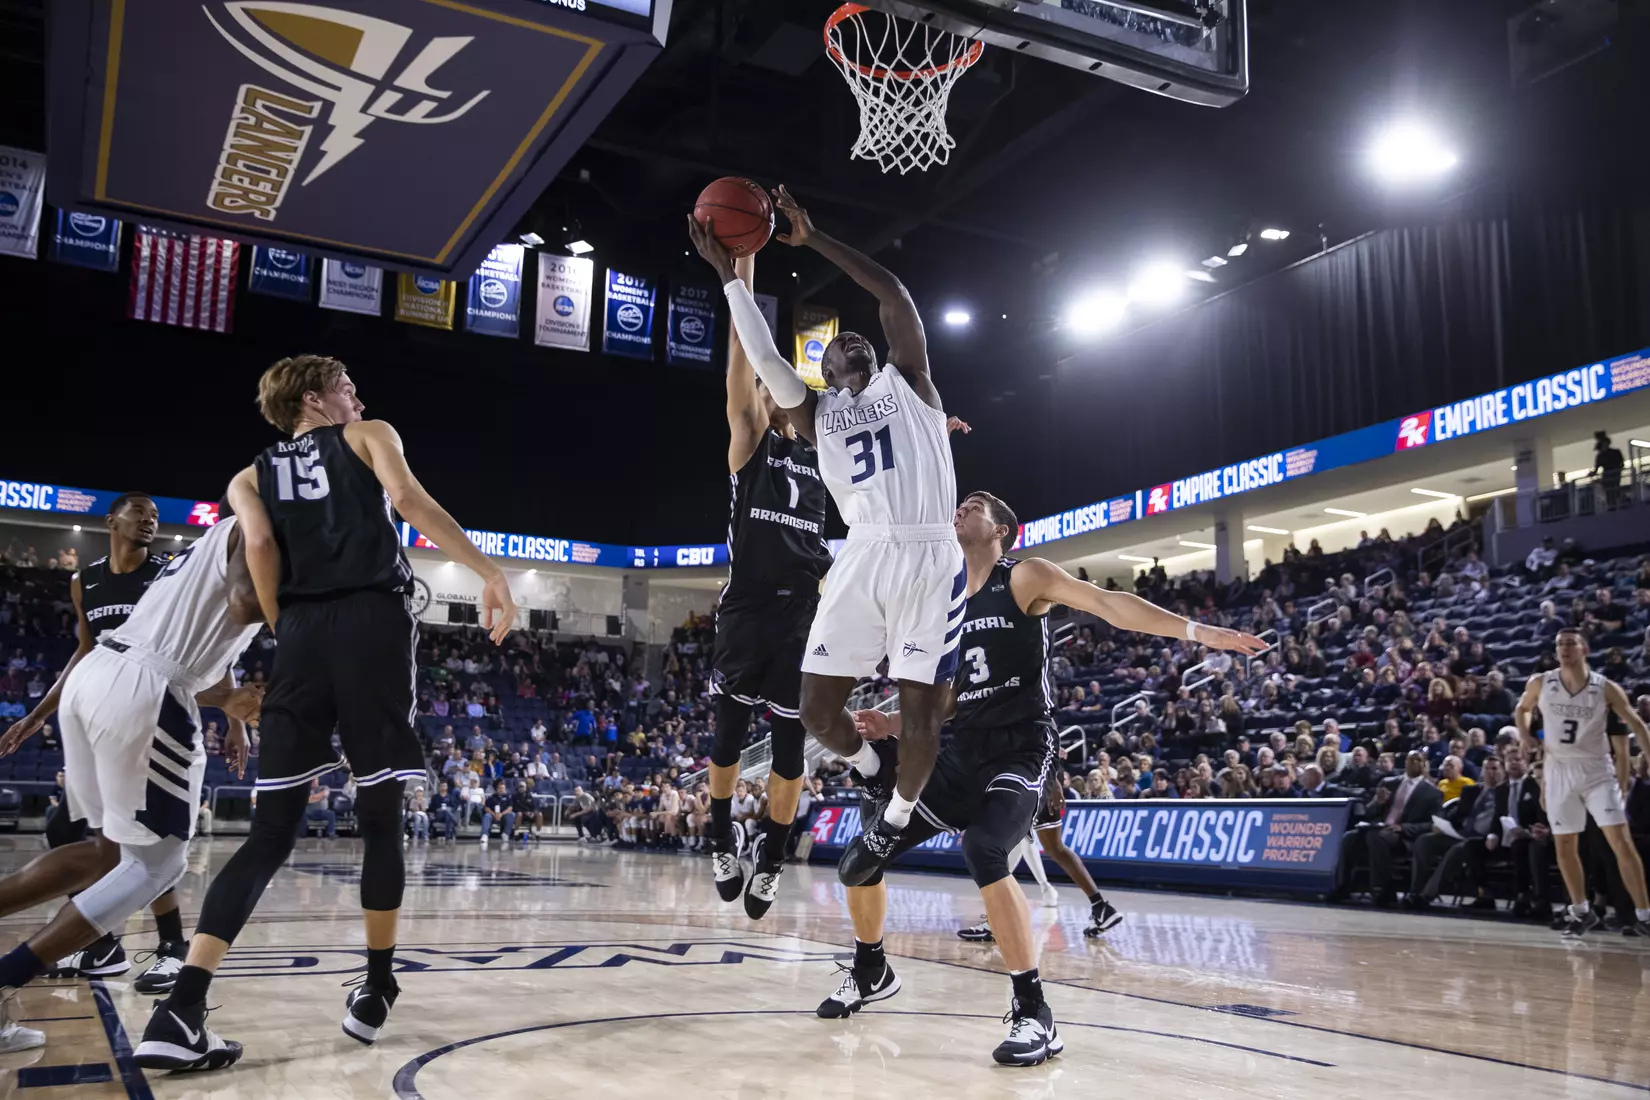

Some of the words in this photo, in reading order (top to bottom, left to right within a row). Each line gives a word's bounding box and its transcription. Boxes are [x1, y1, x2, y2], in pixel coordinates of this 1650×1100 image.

[0, 155, 28, 170] 014
[206, 83, 323, 221] LANCERS
[611, 283, 649, 297] WOMEN'S
[617, 272, 646, 288] 2017
[467, 307, 517, 321] CHAMPIONS
[605, 330, 651, 345] CHAMPIONS
[822, 394, 899, 436] LANCERS
[1398, 417, 1428, 447] 2K
[1434, 390, 1509, 441] EMPIRE
[1511, 364, 1607, 421] CLASSIC
[845, 424, 895, 485] 31
[271, 449, 330, 501] 15
[1172, 470, 1222, 509] EMPIRE
[1223, 453, 1284, 496] CLASSIC
[0, 480, 53, 511] ASSIC
[787, 476, 800, 509] 1
[191, 503, 219, 525] 2K
[750, 507, 819, 534] ARKANSAS
[1024, 513, 1063, 547] EMPIRE
[1063, 502, 1109, 537] CLASSIC
[465, 530, 505, 556] PIRE
[508, 535, 569, 563] CLASSIC
[676, 547, 715, 566] CBU
[436, 591, 478, 602] GLOBALLY
[86, 604, 136, 622] CENTR
[961, 616, 1015, 634] TRAL
[965, 646, 990, 684] 3
[1560, 719, 1579, 745] 3
[813, 809, 834, 842] 2K
[1062, 809, 1149, 858] EMPIRE
[1144, 809, 1263, 863] CLASSIC
[1269, 822, 1332, 836] WOUNDED
[1262, 848, 1317, 863] PROJECT
[1266, 835, 1323, 850] WARRIOR
